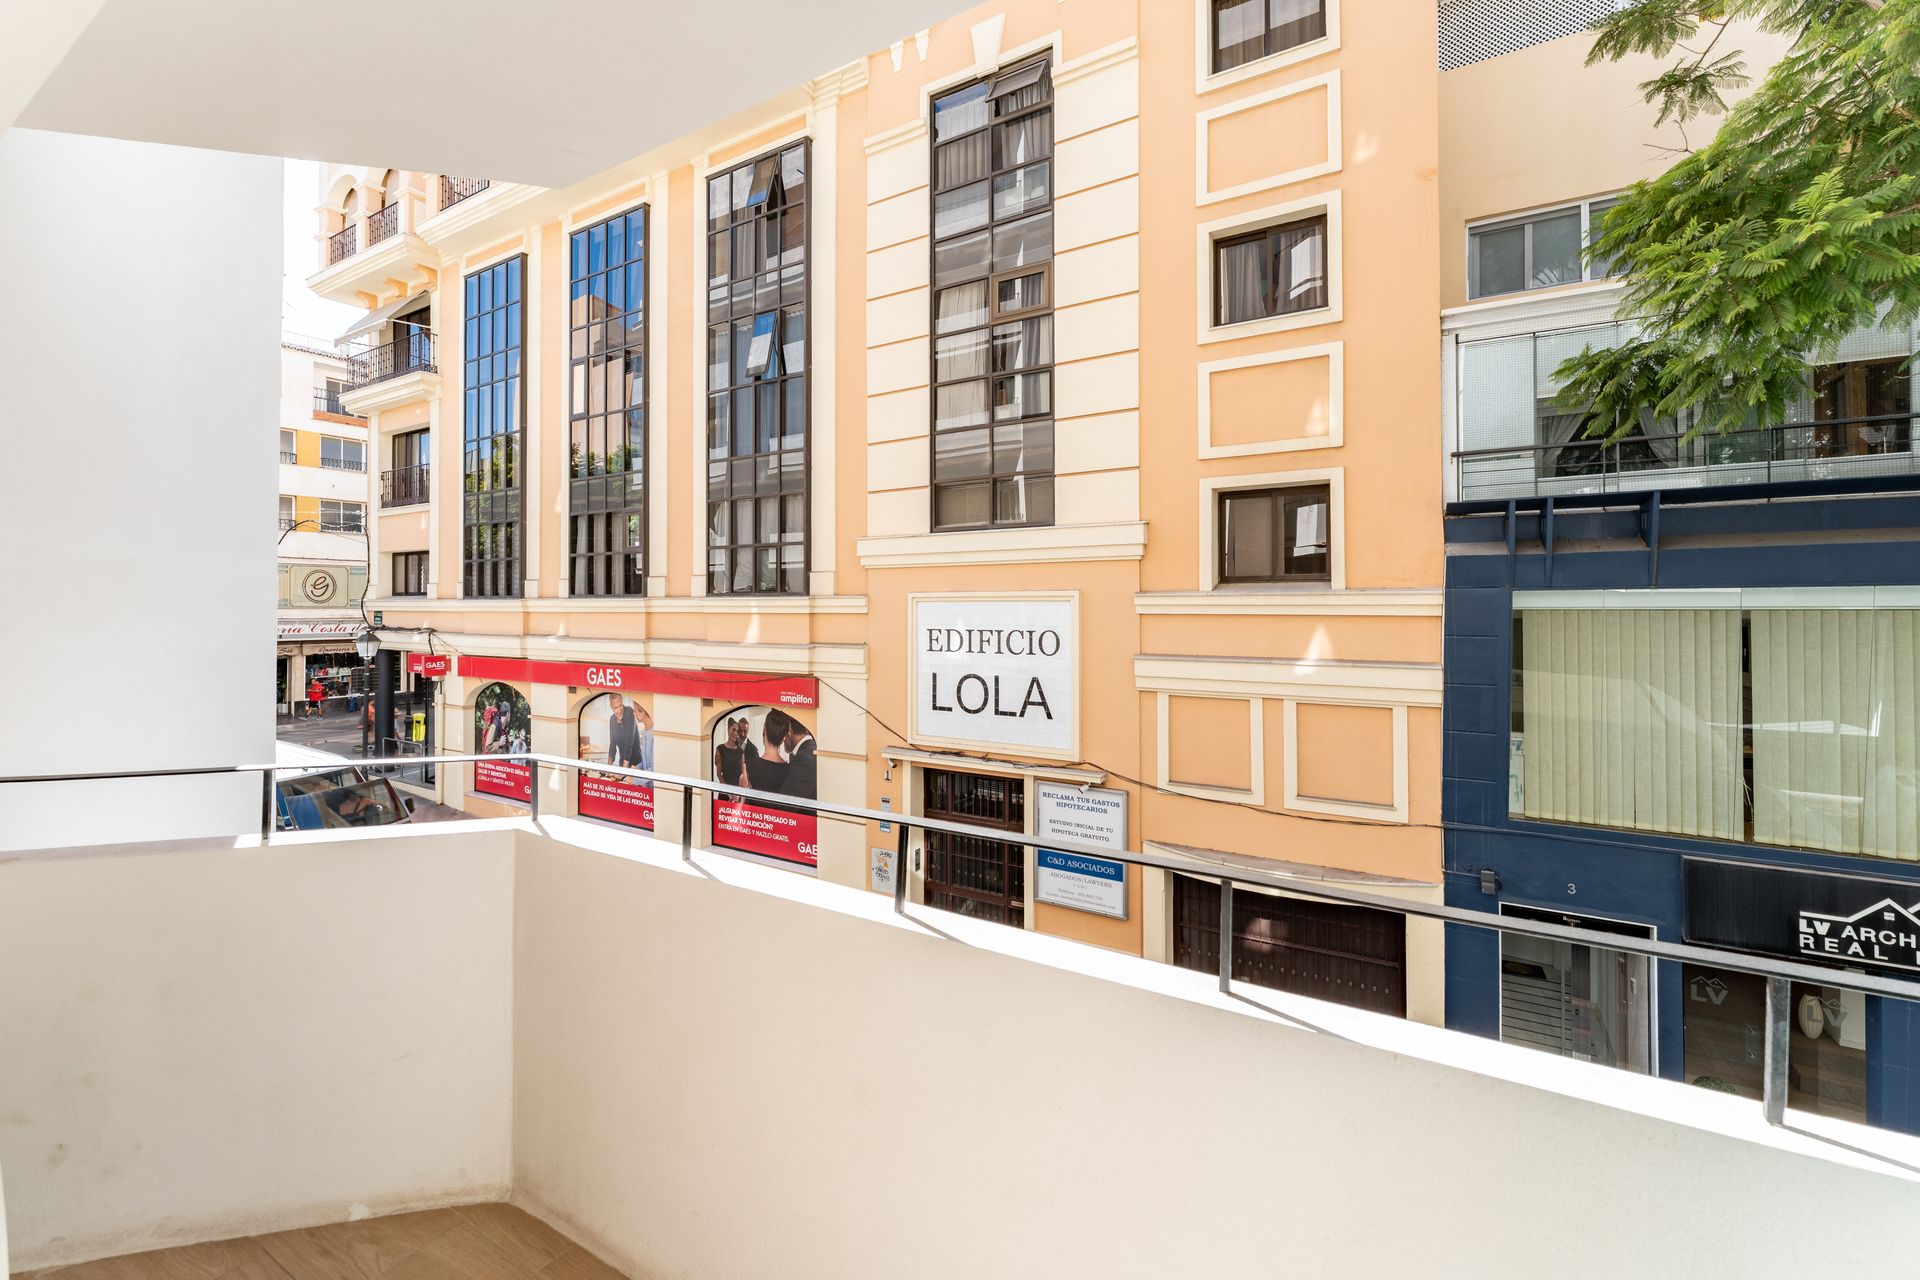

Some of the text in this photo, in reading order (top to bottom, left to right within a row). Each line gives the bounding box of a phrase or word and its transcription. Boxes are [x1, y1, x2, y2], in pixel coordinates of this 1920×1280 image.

[926, 628, 1061, 657] EDIFICIO
[587, 667, 622, 686] GAES
[780, 694, 812, 704] amplifon
[931, 672, 1054, 721] LOLA
[884, 770, 891, 781] 1
[583, 789, 600, 797] CALIDAD
[605, 785, 616, 793] AÑOS
[617, 788, 643, 798] MEJORANDO
[1043, 792, 1074, 801] RECLAMA
[1092, 799, 1120, 808] GASTOS
[1056, 802, 1108, 814] HIPOTECARIOS
[718, 814, 739, 824] REVISAR
[746, 820, 774, 831] AUDICIÓN?
[764, 814, 788, 824] PENSADO
[756, 829, 772, 838] HAZLO
[1052, 828, 1079, 836] HIPOTECA
[1047, 856, 1115, 875] C&D ASOCIADOS
[1567, 883, 1576, 895] 3
[1799, 918, 1916, 949] LV ARCH
[1799, 933, 1888, 960] REAL
[1691, 984, 1728, 1005] LV
[1807, 1004, 1848, 1027] LV
